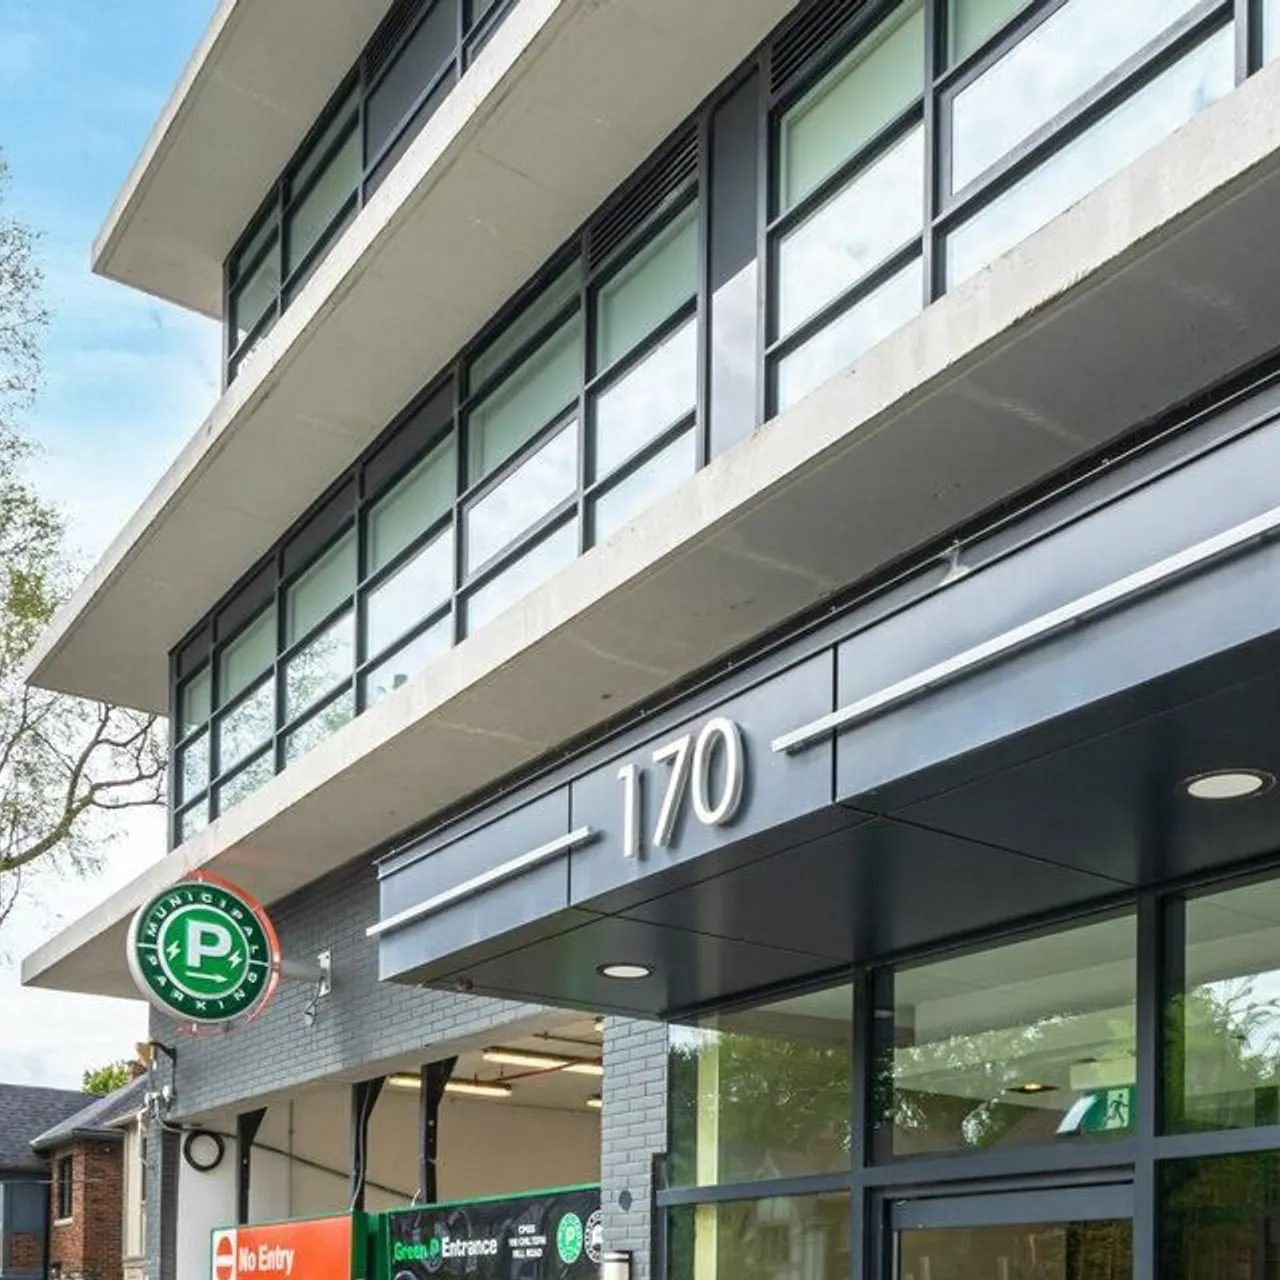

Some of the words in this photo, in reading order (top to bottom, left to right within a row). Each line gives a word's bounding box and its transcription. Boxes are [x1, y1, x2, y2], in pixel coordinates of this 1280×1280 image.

[617, 717, 744, 859] 170
[147, 892, 259, 953] MUNICIPAL
[185, 918, 232, 968] P
[147, 956, 258, 1010] PARKING
[239, 1246, 257, 1273] No
[259, 1243, 295, 1277] Entry
[394, 1240, 428, 1261] Green
[441, 1236, 498, 1258] Entrance
